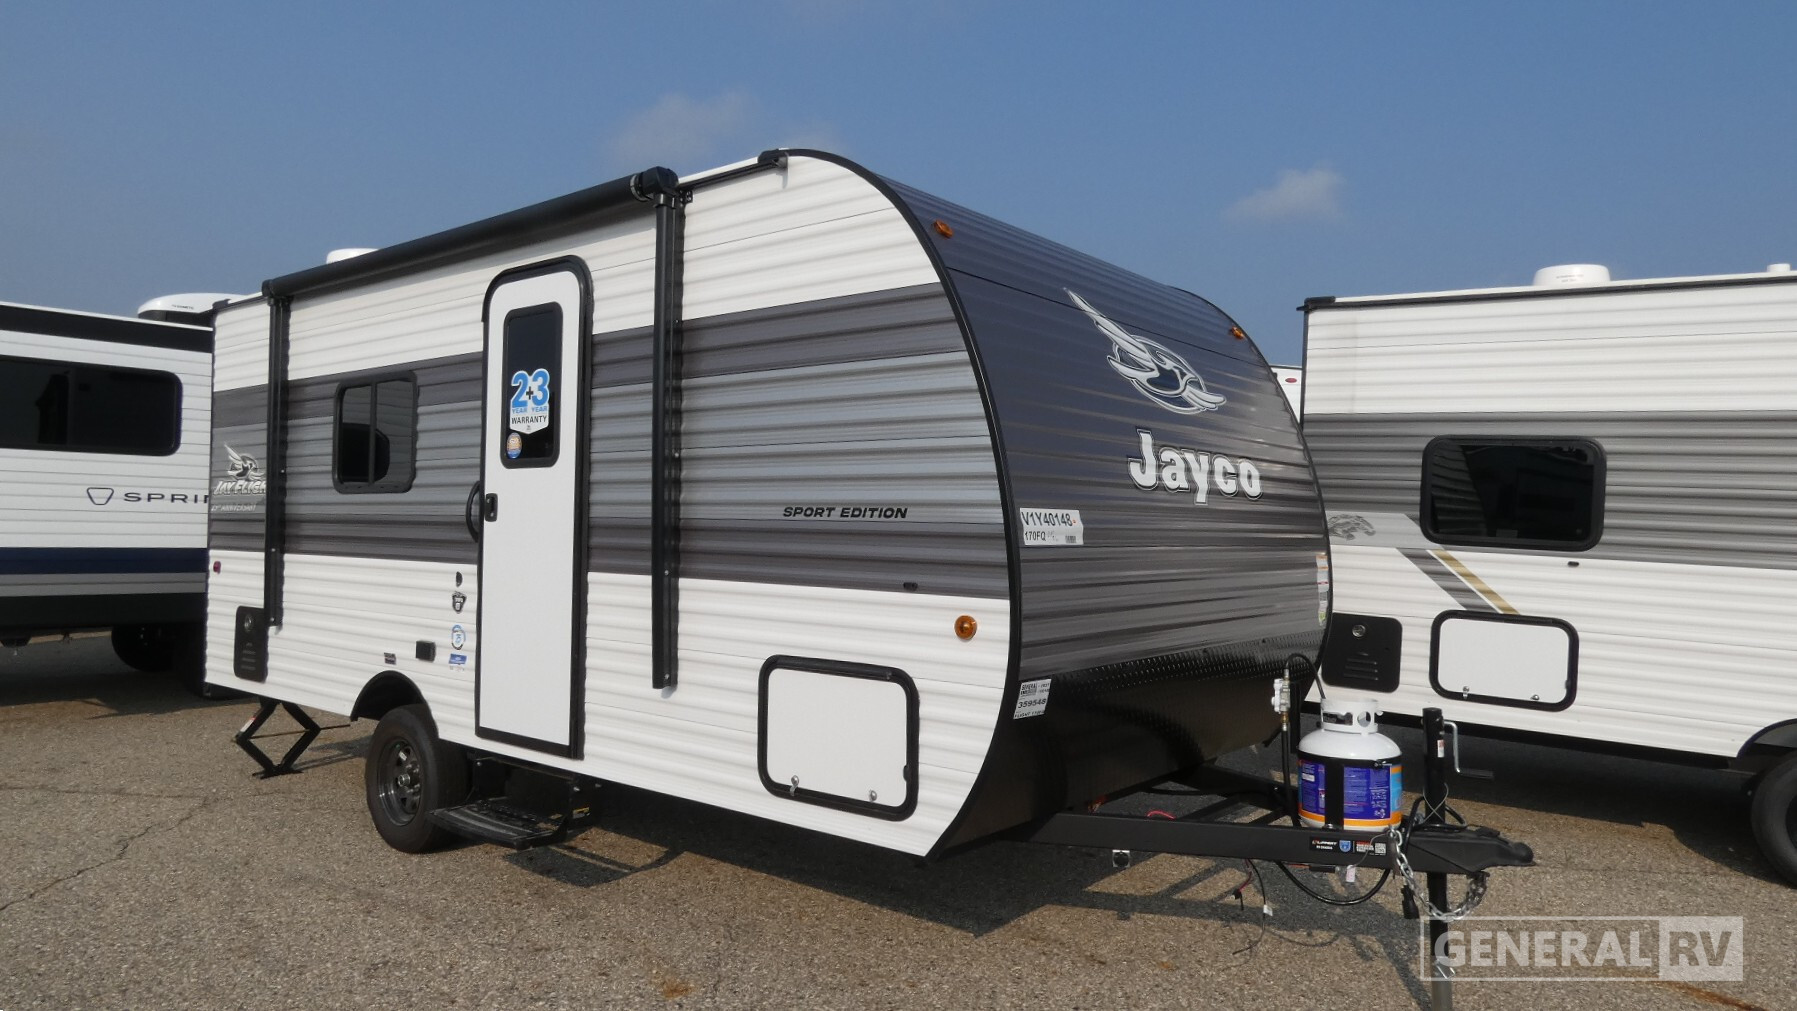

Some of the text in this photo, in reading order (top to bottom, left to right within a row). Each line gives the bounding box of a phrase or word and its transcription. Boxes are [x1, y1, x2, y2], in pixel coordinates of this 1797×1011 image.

[512, 405, 548, 415] YEAR YEAR
[511, 415, 547, 425] WARRANTY
[1128, 429, 1263, 505] Jayco
[213, 481, 237, 496] JAY
[783, 506, 908, 519] SPORT EDITION
[1025, 531, 1046, 541] 170FQ
[1017, 698, 1047, 709] 359548
